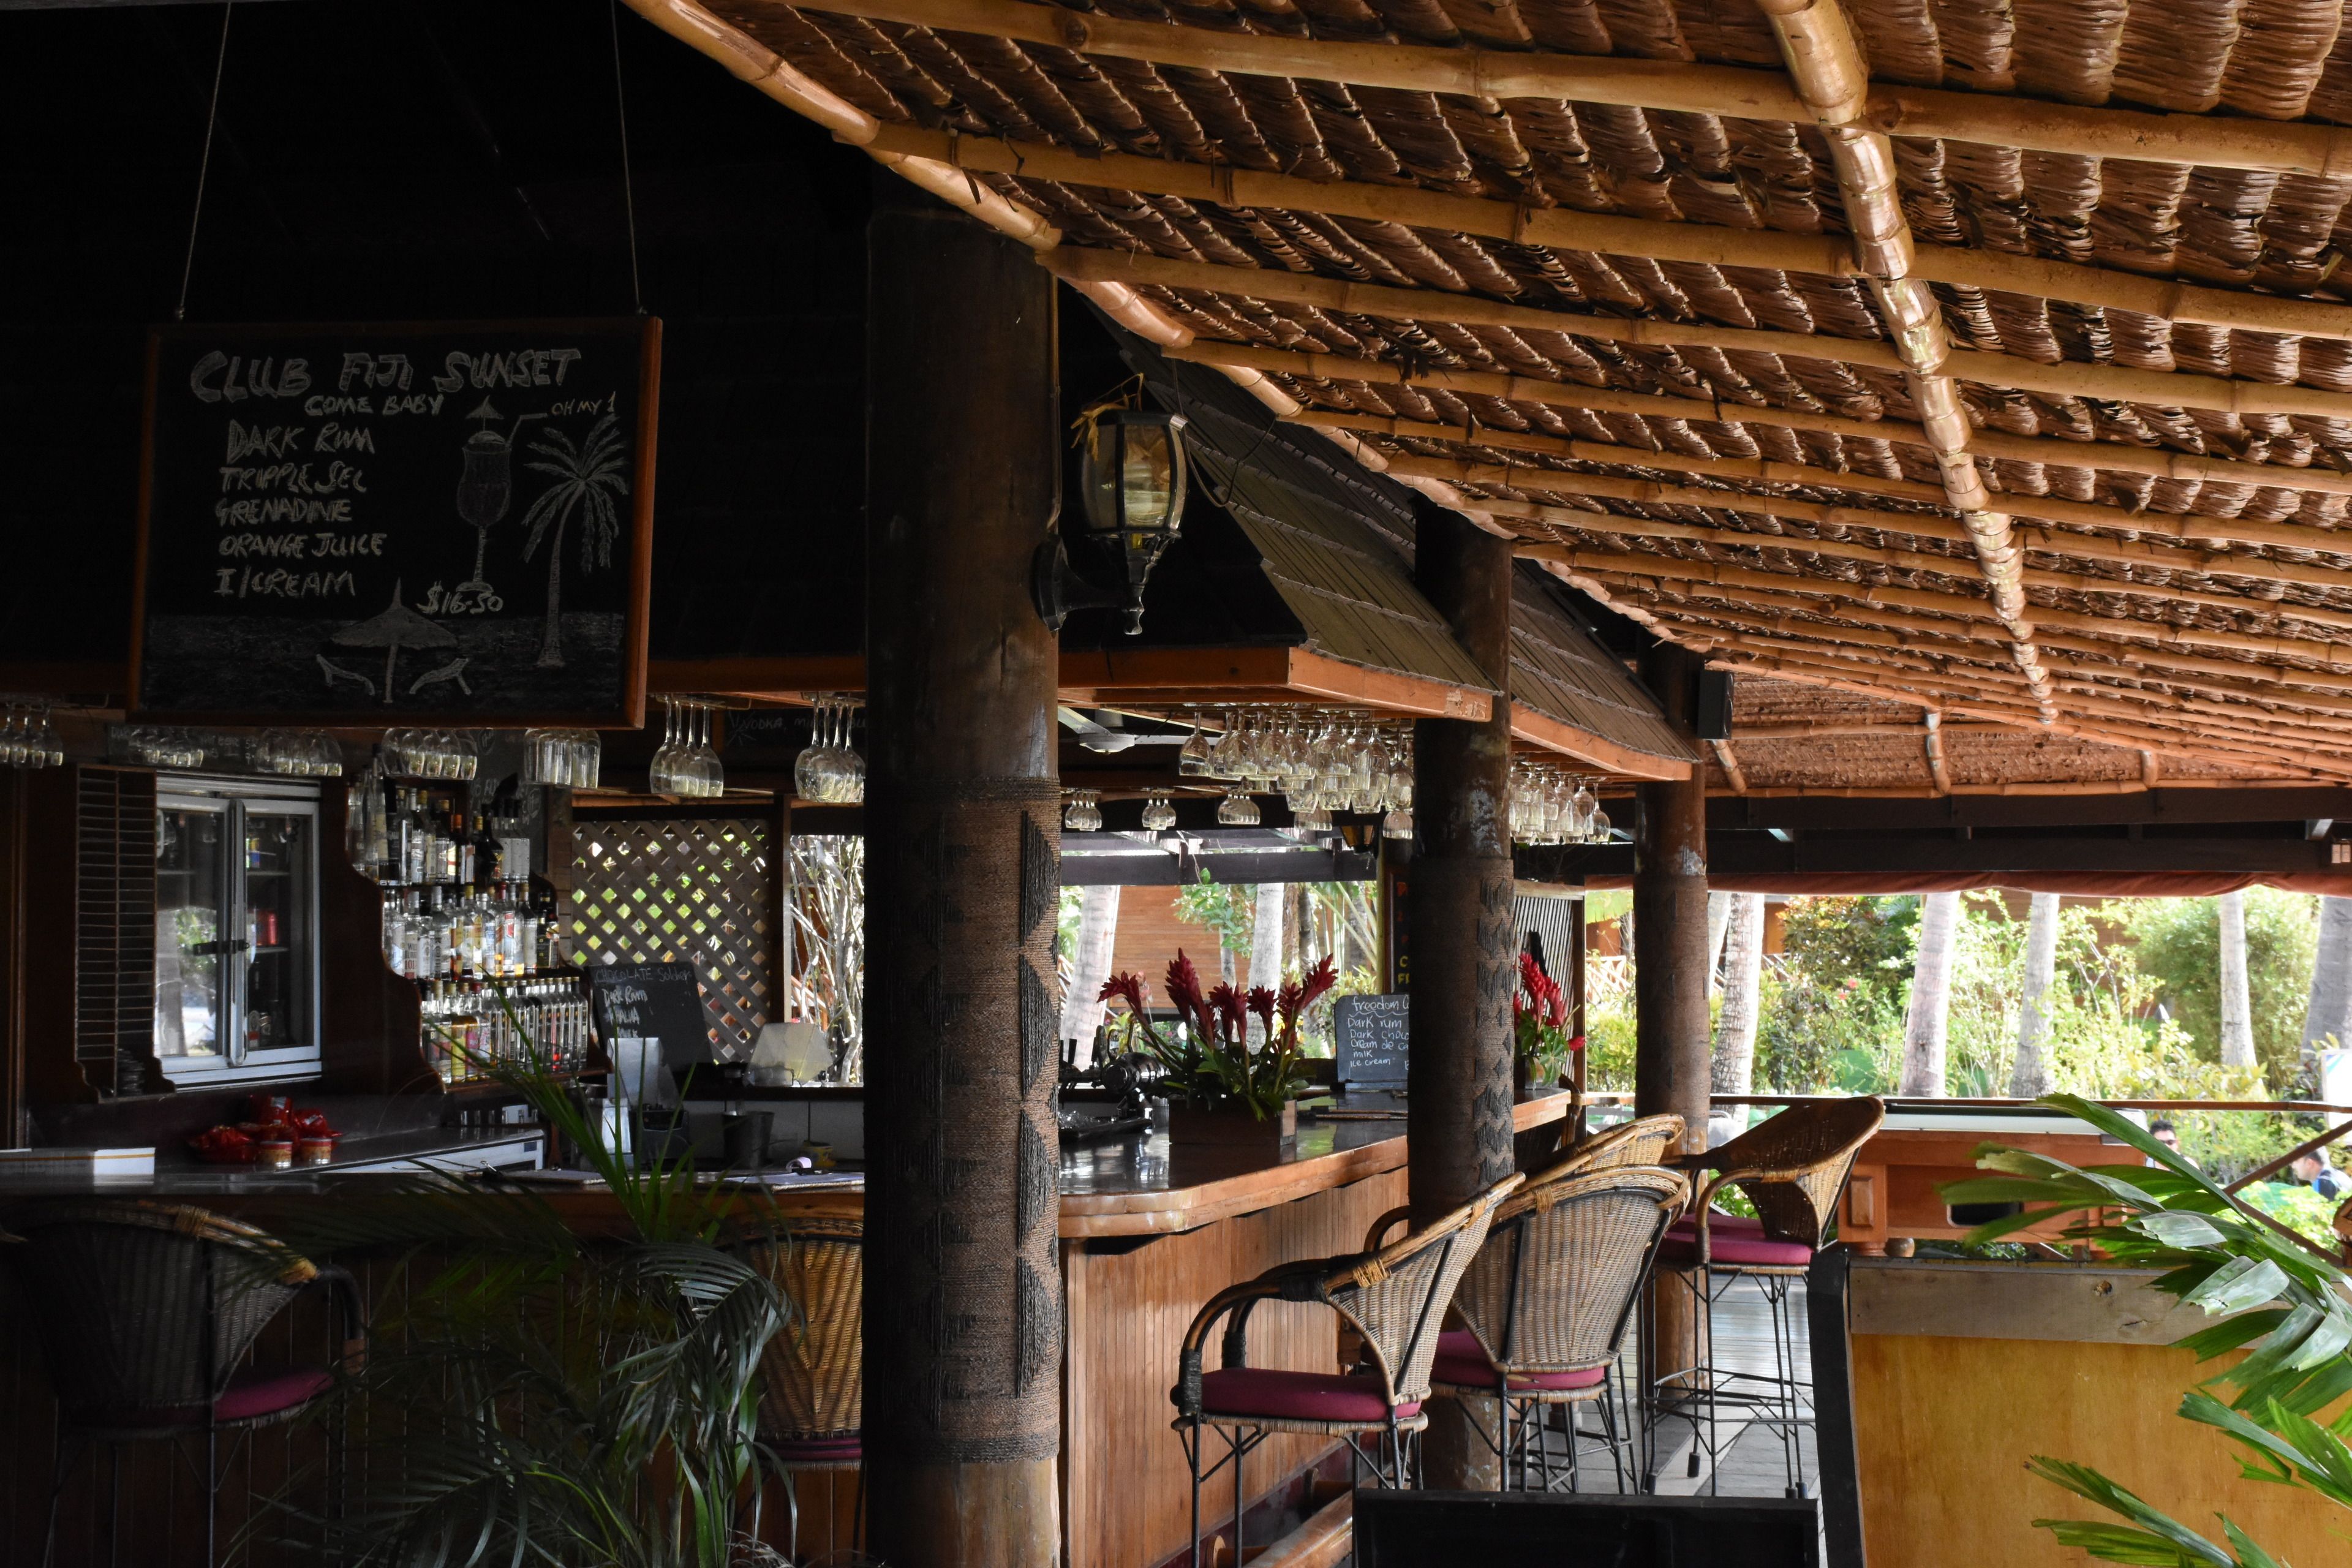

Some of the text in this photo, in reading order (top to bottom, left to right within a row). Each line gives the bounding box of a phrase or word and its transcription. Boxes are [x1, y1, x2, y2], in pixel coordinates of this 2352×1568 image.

[190, 349, 581, 403] CLUB FIJI SUNSET
[304, 393, 445, 416] COME BABY
[551, 399, 575, 415] OH
[227, 418, 375, 465] DARK RUM
[219, 460, 368, 494] TRIPPLE SEC
[215, 497, 353, 527] GRENADINE
[219, 532, 388, 560] ORANGE JUICE
[1352, 995, 1399, 1011] freedom
[1380, 1019, 1402, 1028] rum
